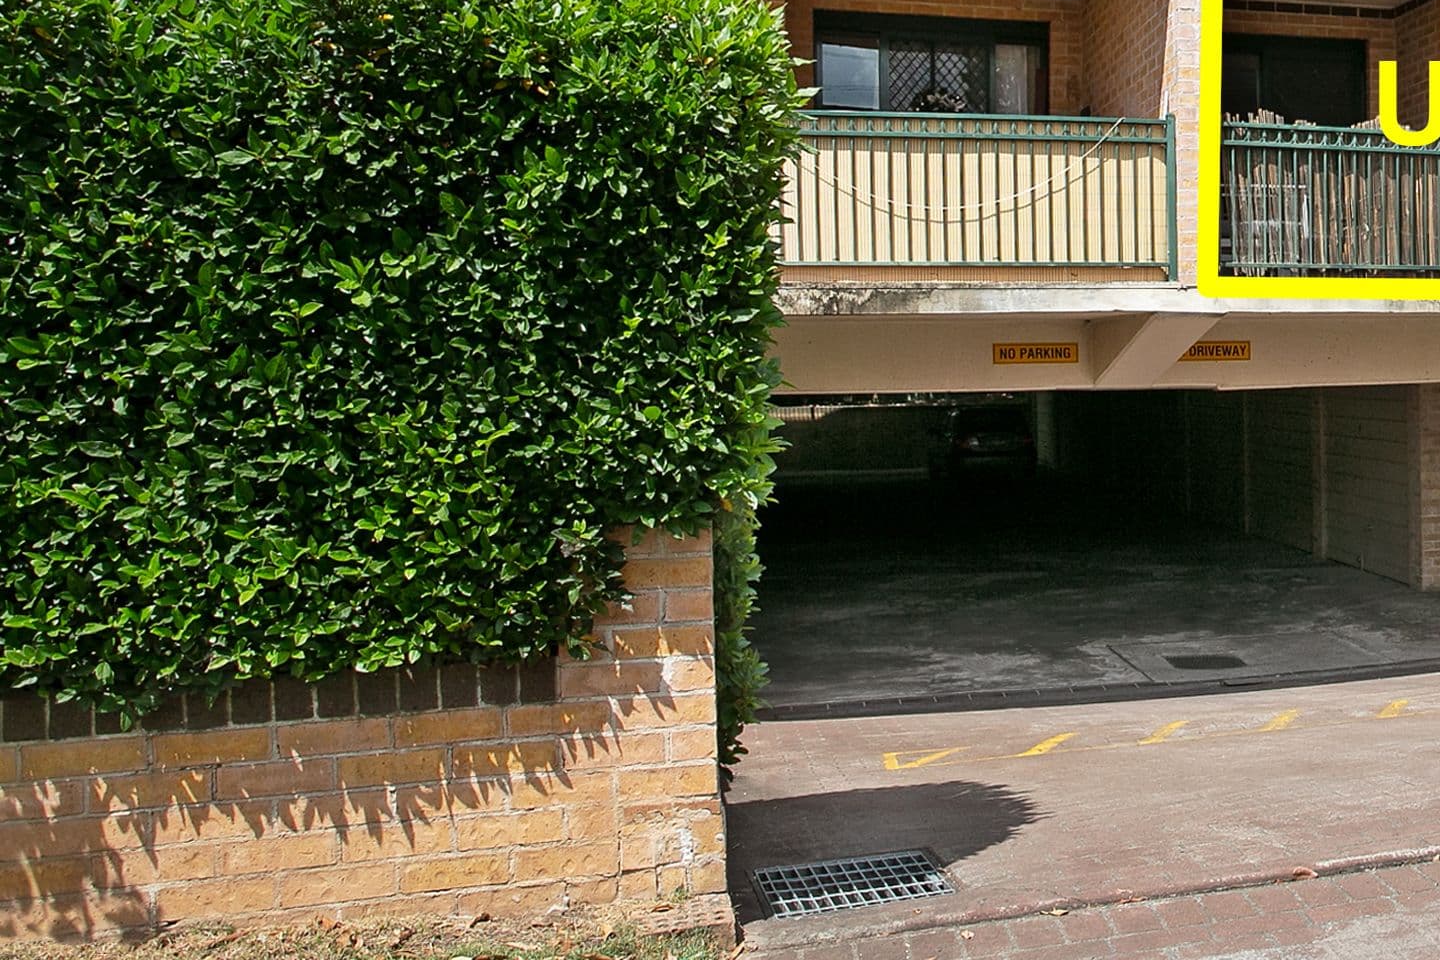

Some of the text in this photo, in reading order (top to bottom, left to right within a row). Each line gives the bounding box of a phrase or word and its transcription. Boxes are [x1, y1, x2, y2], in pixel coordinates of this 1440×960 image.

[1000, 347, 1071, 359] NO PARKING
[1188, 345, 1247, 357] DRIVEWAY
